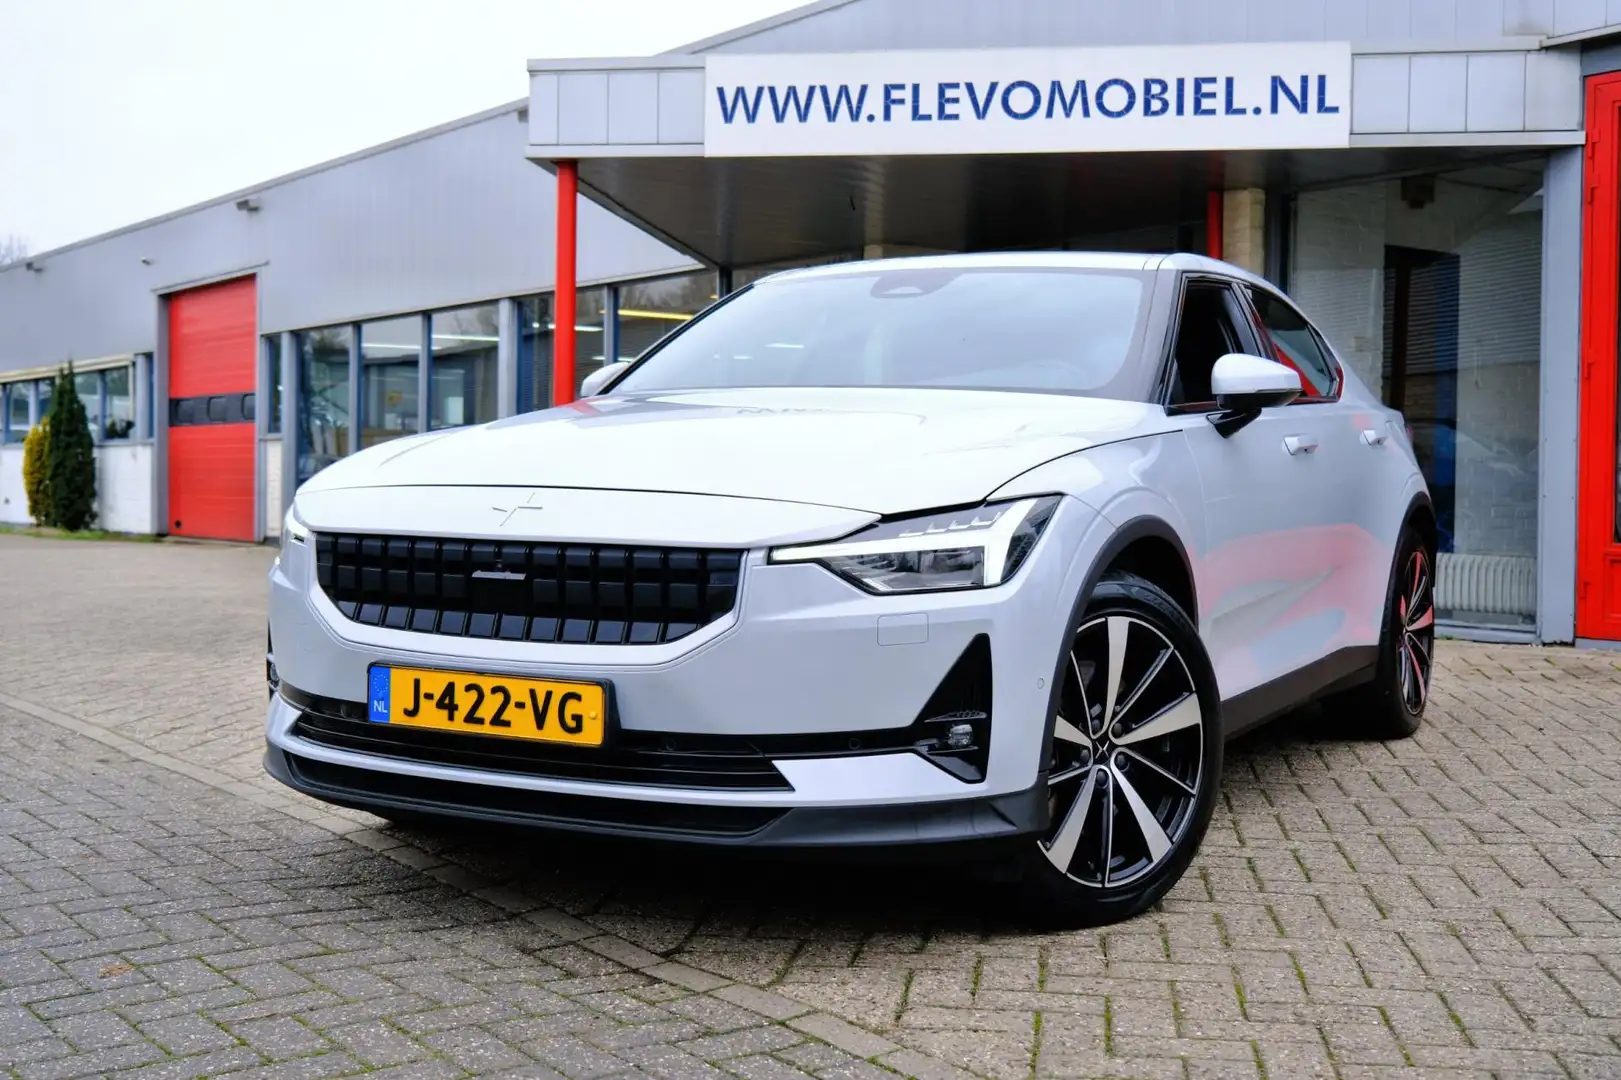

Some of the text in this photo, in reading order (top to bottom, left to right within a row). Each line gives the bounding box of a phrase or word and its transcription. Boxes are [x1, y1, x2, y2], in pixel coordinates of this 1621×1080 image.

[716, 74, 1340, 124] WWW.FLEVOMOBIEL.NL
[373, 700, 388, 713] NL
[403, 678, 583, 734] J-422-VG
